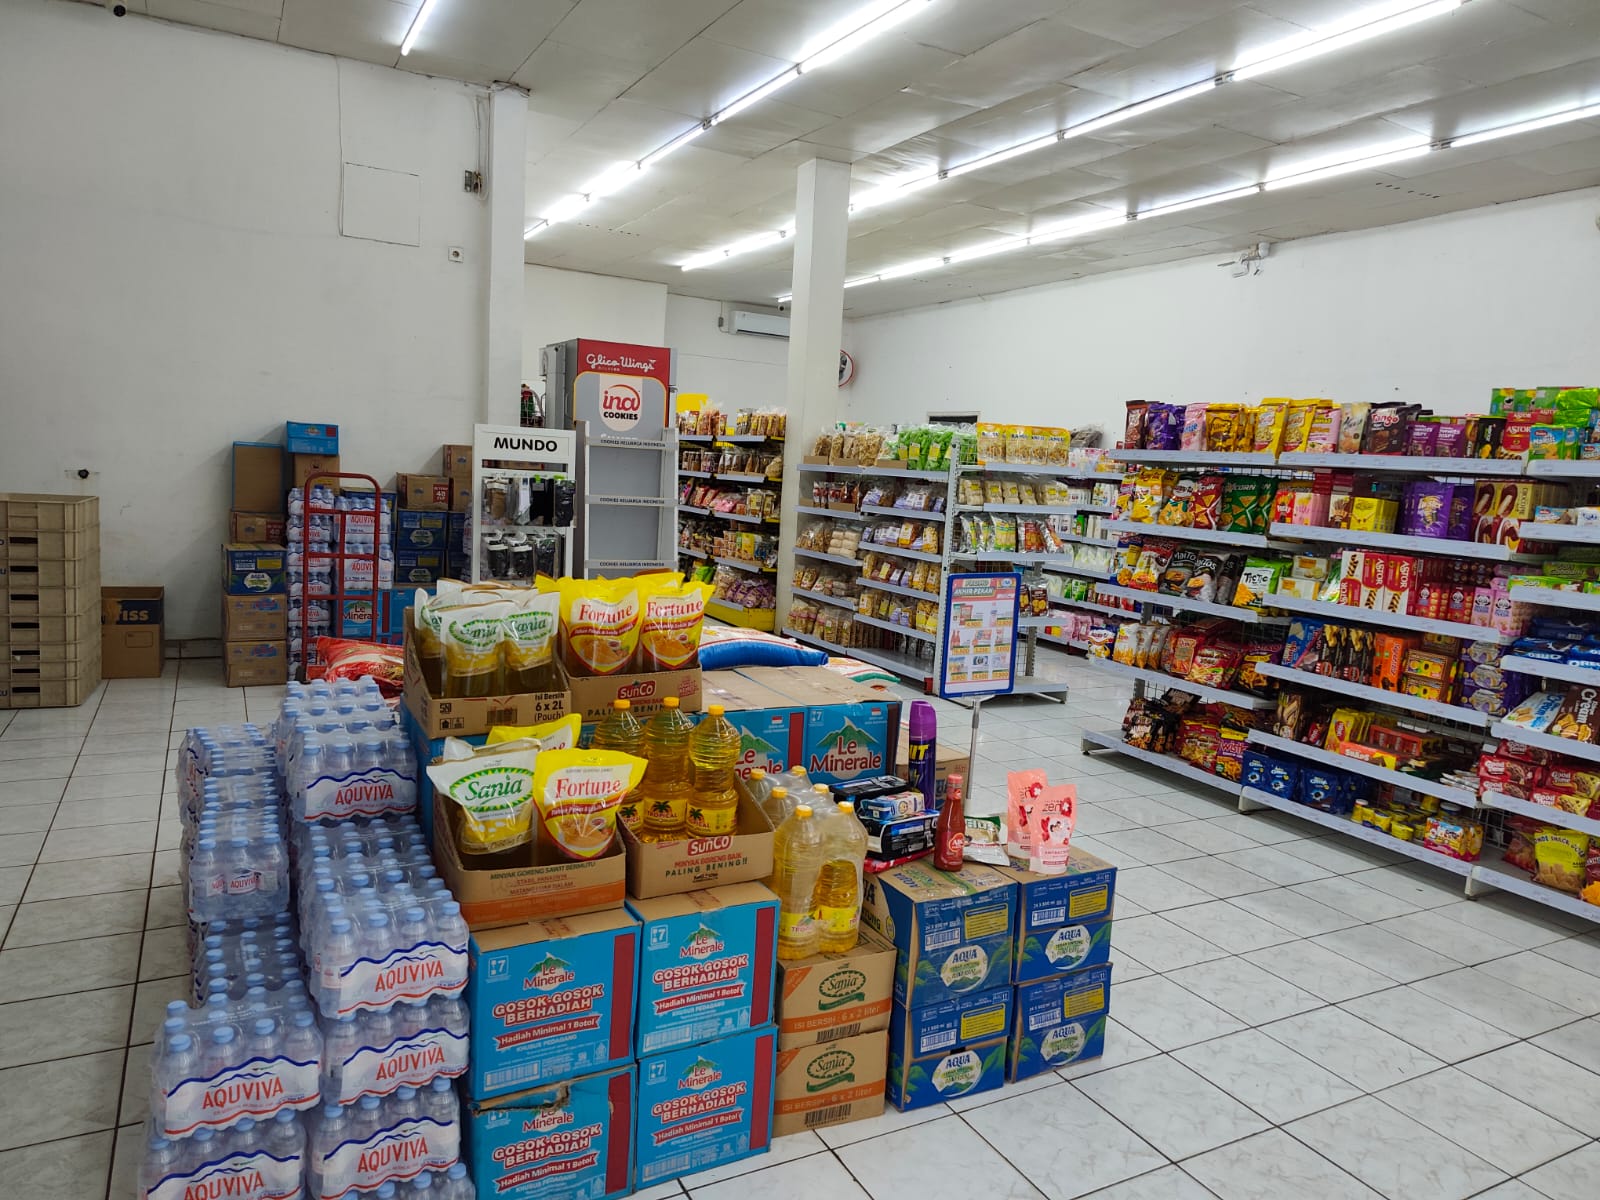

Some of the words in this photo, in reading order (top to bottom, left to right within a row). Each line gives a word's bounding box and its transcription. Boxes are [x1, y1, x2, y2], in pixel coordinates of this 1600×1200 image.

[586, 353, 620, 369] Glico
[620, 357, 655, 373] Wings
[602, 389, 641, 412] ina
[603, 411, 638, 420] COOKIES
[1371, 413, 1399, 427] Tango
[494, 437, 558, 452] MUNDO
[1375, 558, 1385, 585] ASTOR
[1400, 560, 1410, 588] ASTOR
[354, 604, 366, 613] Le
[578, 604, 632, 624] Fortune
[647, 600, 703, 617] Fortune
[620, 684, 653, 699] SunCo
[535, 702, 542, 711] 6
[552, 701, 564, 711] 2L
[1576, 688, 1598, 724] Cream
[535, 710, 565, 722] (Pouch)
[838, 736, 857, 755] Le
[735, 749, 756, 765] Le
[809, 754, 882, 774] Minerale
[1552, 771, 1571, 779] Good
[335, 784, 394, 805] AQUVIVA
[465, 774, 524, 801] Sania
[555, 778, 622, 799] Fortune
[1042, 803, 1061, 812] zen
[690, 836, 731, 854] SunCo
[665, 866, 701, 878] PALING
[695, 934, 708, 946] Le
[1058, 929, 1081, 941] AQUA
[680, 941, 724, 958] Minerale
[952, 949, 978, 963] AQUA
[375, 960, 444, 992] AQUVIVA
[541, 963, 556, 977] Le
[653, 955, 748, 982] GOSOK-GOSOK
[523, 971, 575, 989] Minerale
[663, 967, 738, 991] BERHADIAH
[827, 974, 858, 993] Sania
[494, 984, 603, 1016] GOSOK-GOSOK
[658, 998, 685, 1010] Hadiah
[686, 991, 715, 1002] Minimal
[721, 988, 739, 996] Botol
[505, 998, 591, 1024] BERHADIAH
[501, 1031, 531, 1044] Hadiah
[532, 1024, 566, 1037] Minimal
[573, 1020, 595, 1029] Botol
[1052, 1026, 1076, 1039] AQUA
[376, 1047, 445, 1081] AQUVIVA
[694, 1066, 706, 1076] Le
[815, 1055, 847, 1073] Sania
[946, 1054, 971, 1069] AQUA
[677, 1072, 721, 1090] Minerale
[202, 1077, 284, 1109] AQUVIVA
[653, 1082, 746, 1114] GOSOK-GOSOK
[662, 1095, 736, 1120] BERHADIAH
[522, 1113, 574, 1132] Minerale
[658, 1128, 684, 1141] Hadiah
[685, 1120, 714, 1132] Minimal
[720, 1114, 738, 1124] Botol
[494, 1123, 601, 1159] GOSOK-GOSOK
[357, 1136, 428, 1173] AQUVIVA
[505, 1139, 589, 1167] BERHADIAH
[500, 1172, 531, 1187] Hadiah
[531, 1165, 565, 1177] Minimal
[572, 1157, 594, 1169] Botol
[184, 1171, 265, 1200] AQUVIVA
